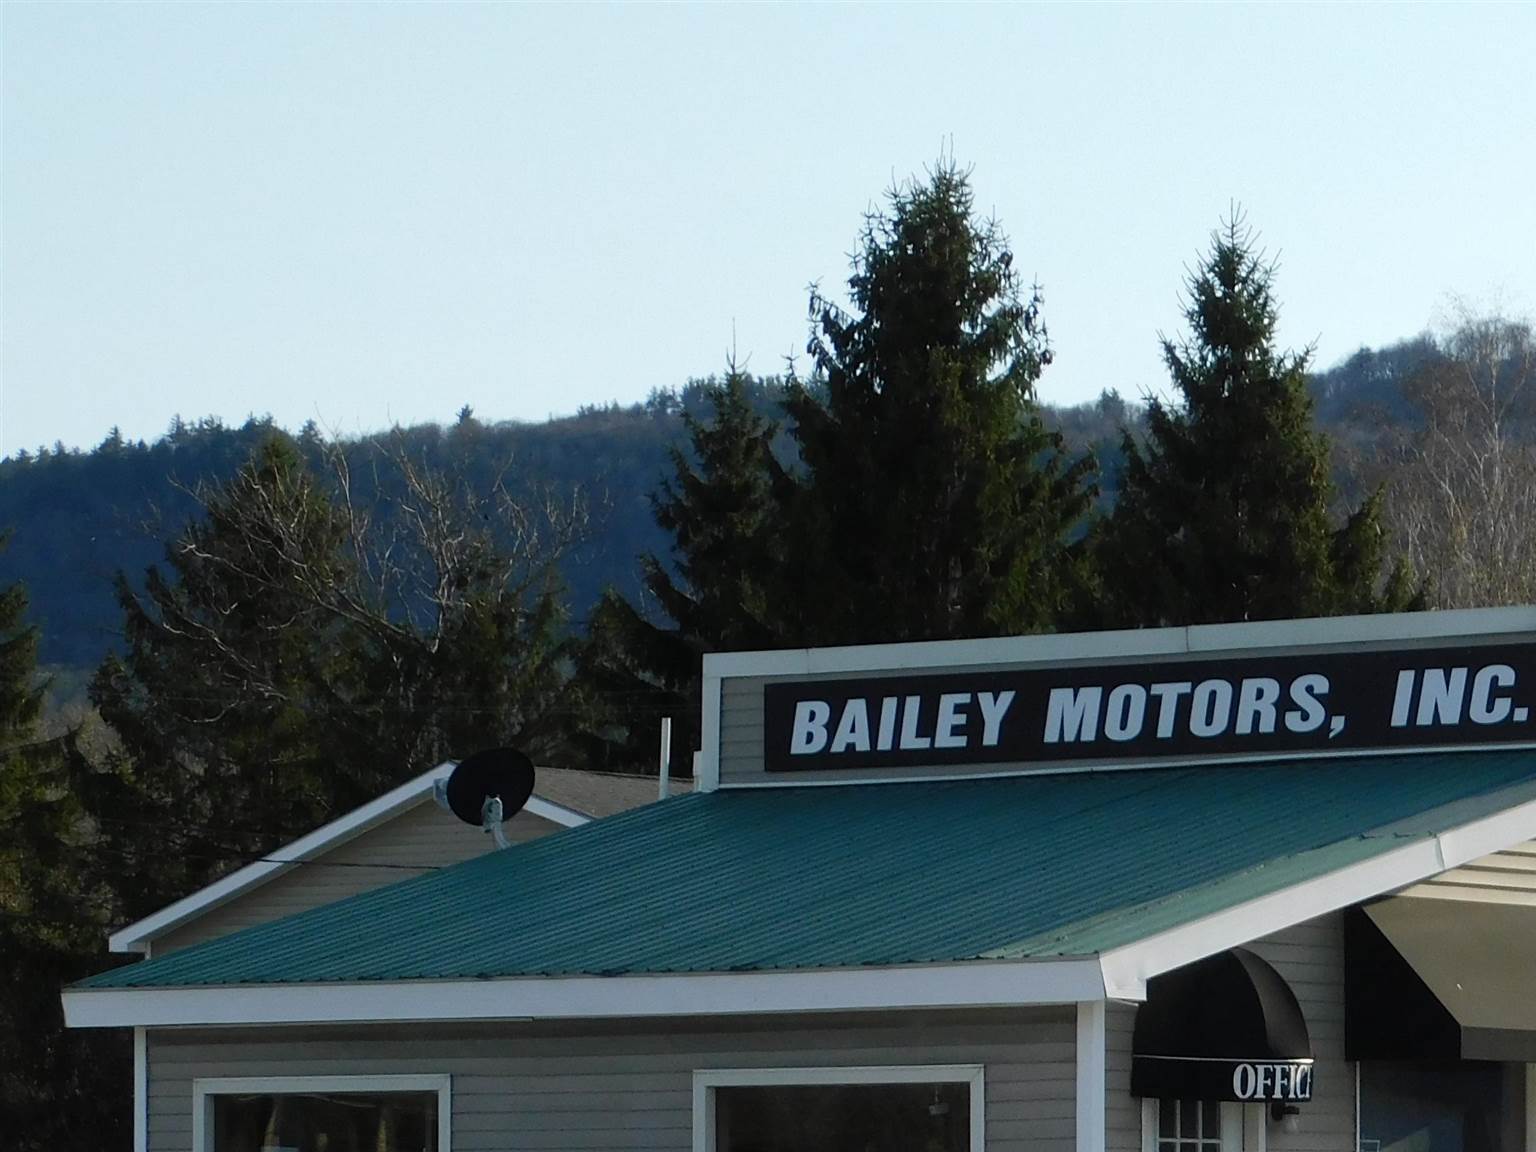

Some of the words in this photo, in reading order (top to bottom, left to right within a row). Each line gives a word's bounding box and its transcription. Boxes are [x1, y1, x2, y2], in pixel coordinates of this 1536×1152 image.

[790, 690, 1015, 754] BAILEY
[1043, 674, 1345, 743] MOTORS,
[1390, 664, 1529, 727] INC.
